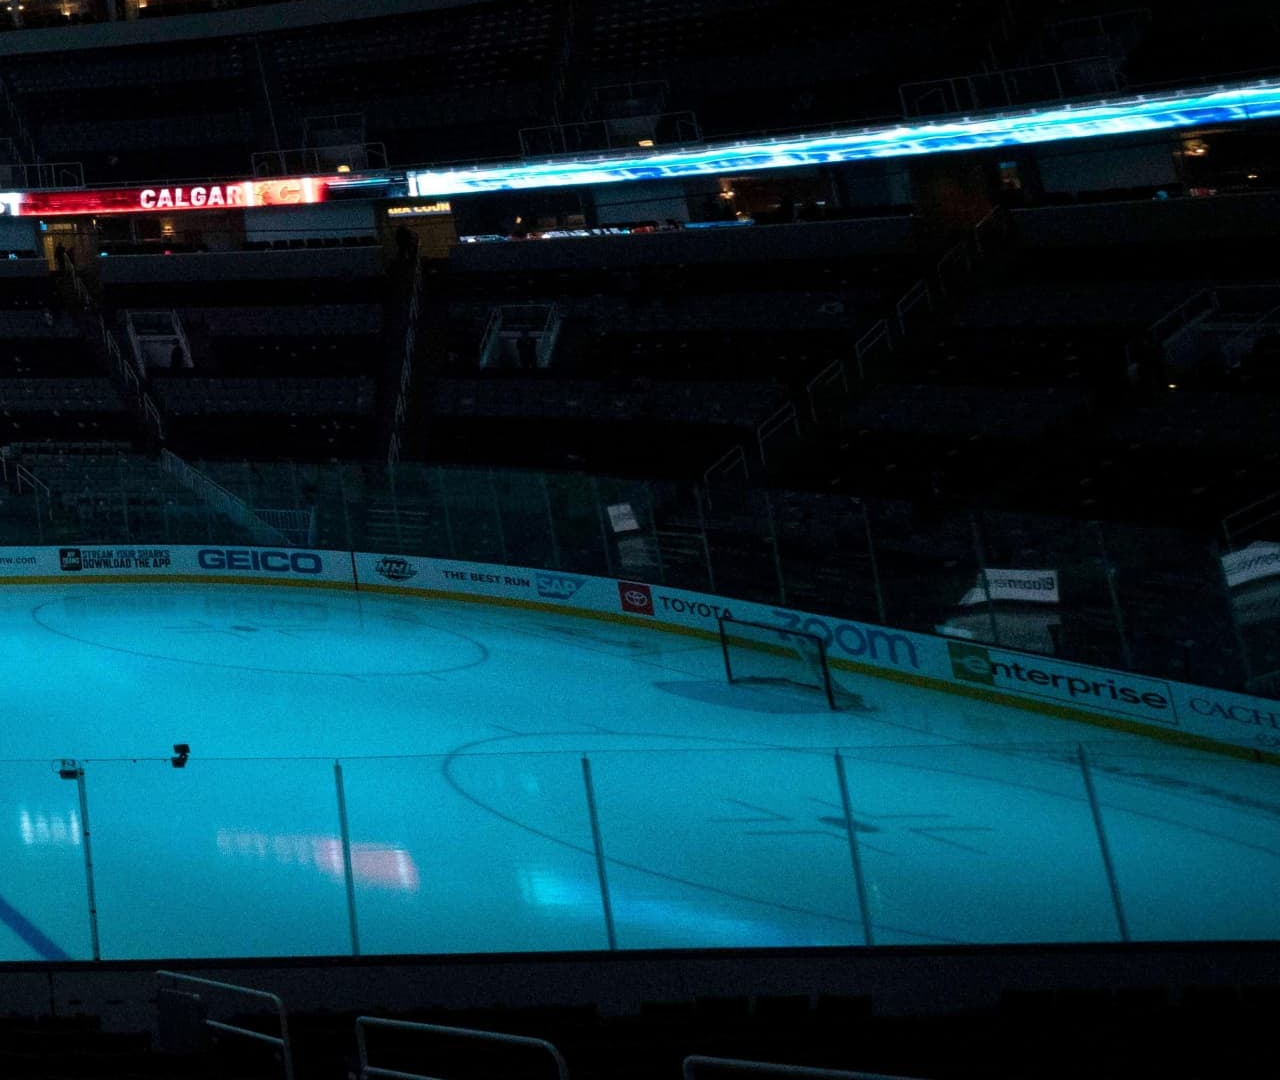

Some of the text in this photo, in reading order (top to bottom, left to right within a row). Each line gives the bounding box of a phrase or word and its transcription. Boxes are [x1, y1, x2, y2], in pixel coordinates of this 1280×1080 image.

[141, 185, 242, 209] CALGAR
[83, 558, 171, 569] DOWNLOAD THE APP
[198, 549, 323, 574] GEICO
[443, 570, 530, 588] THE BEST RUN
[538, 575, 578, 595] SAP
[659, 596, 733, 620] TOYOTA
[964, 654, 1170, 710] enterprise
[1190, 697, 1280, 729] CACH
